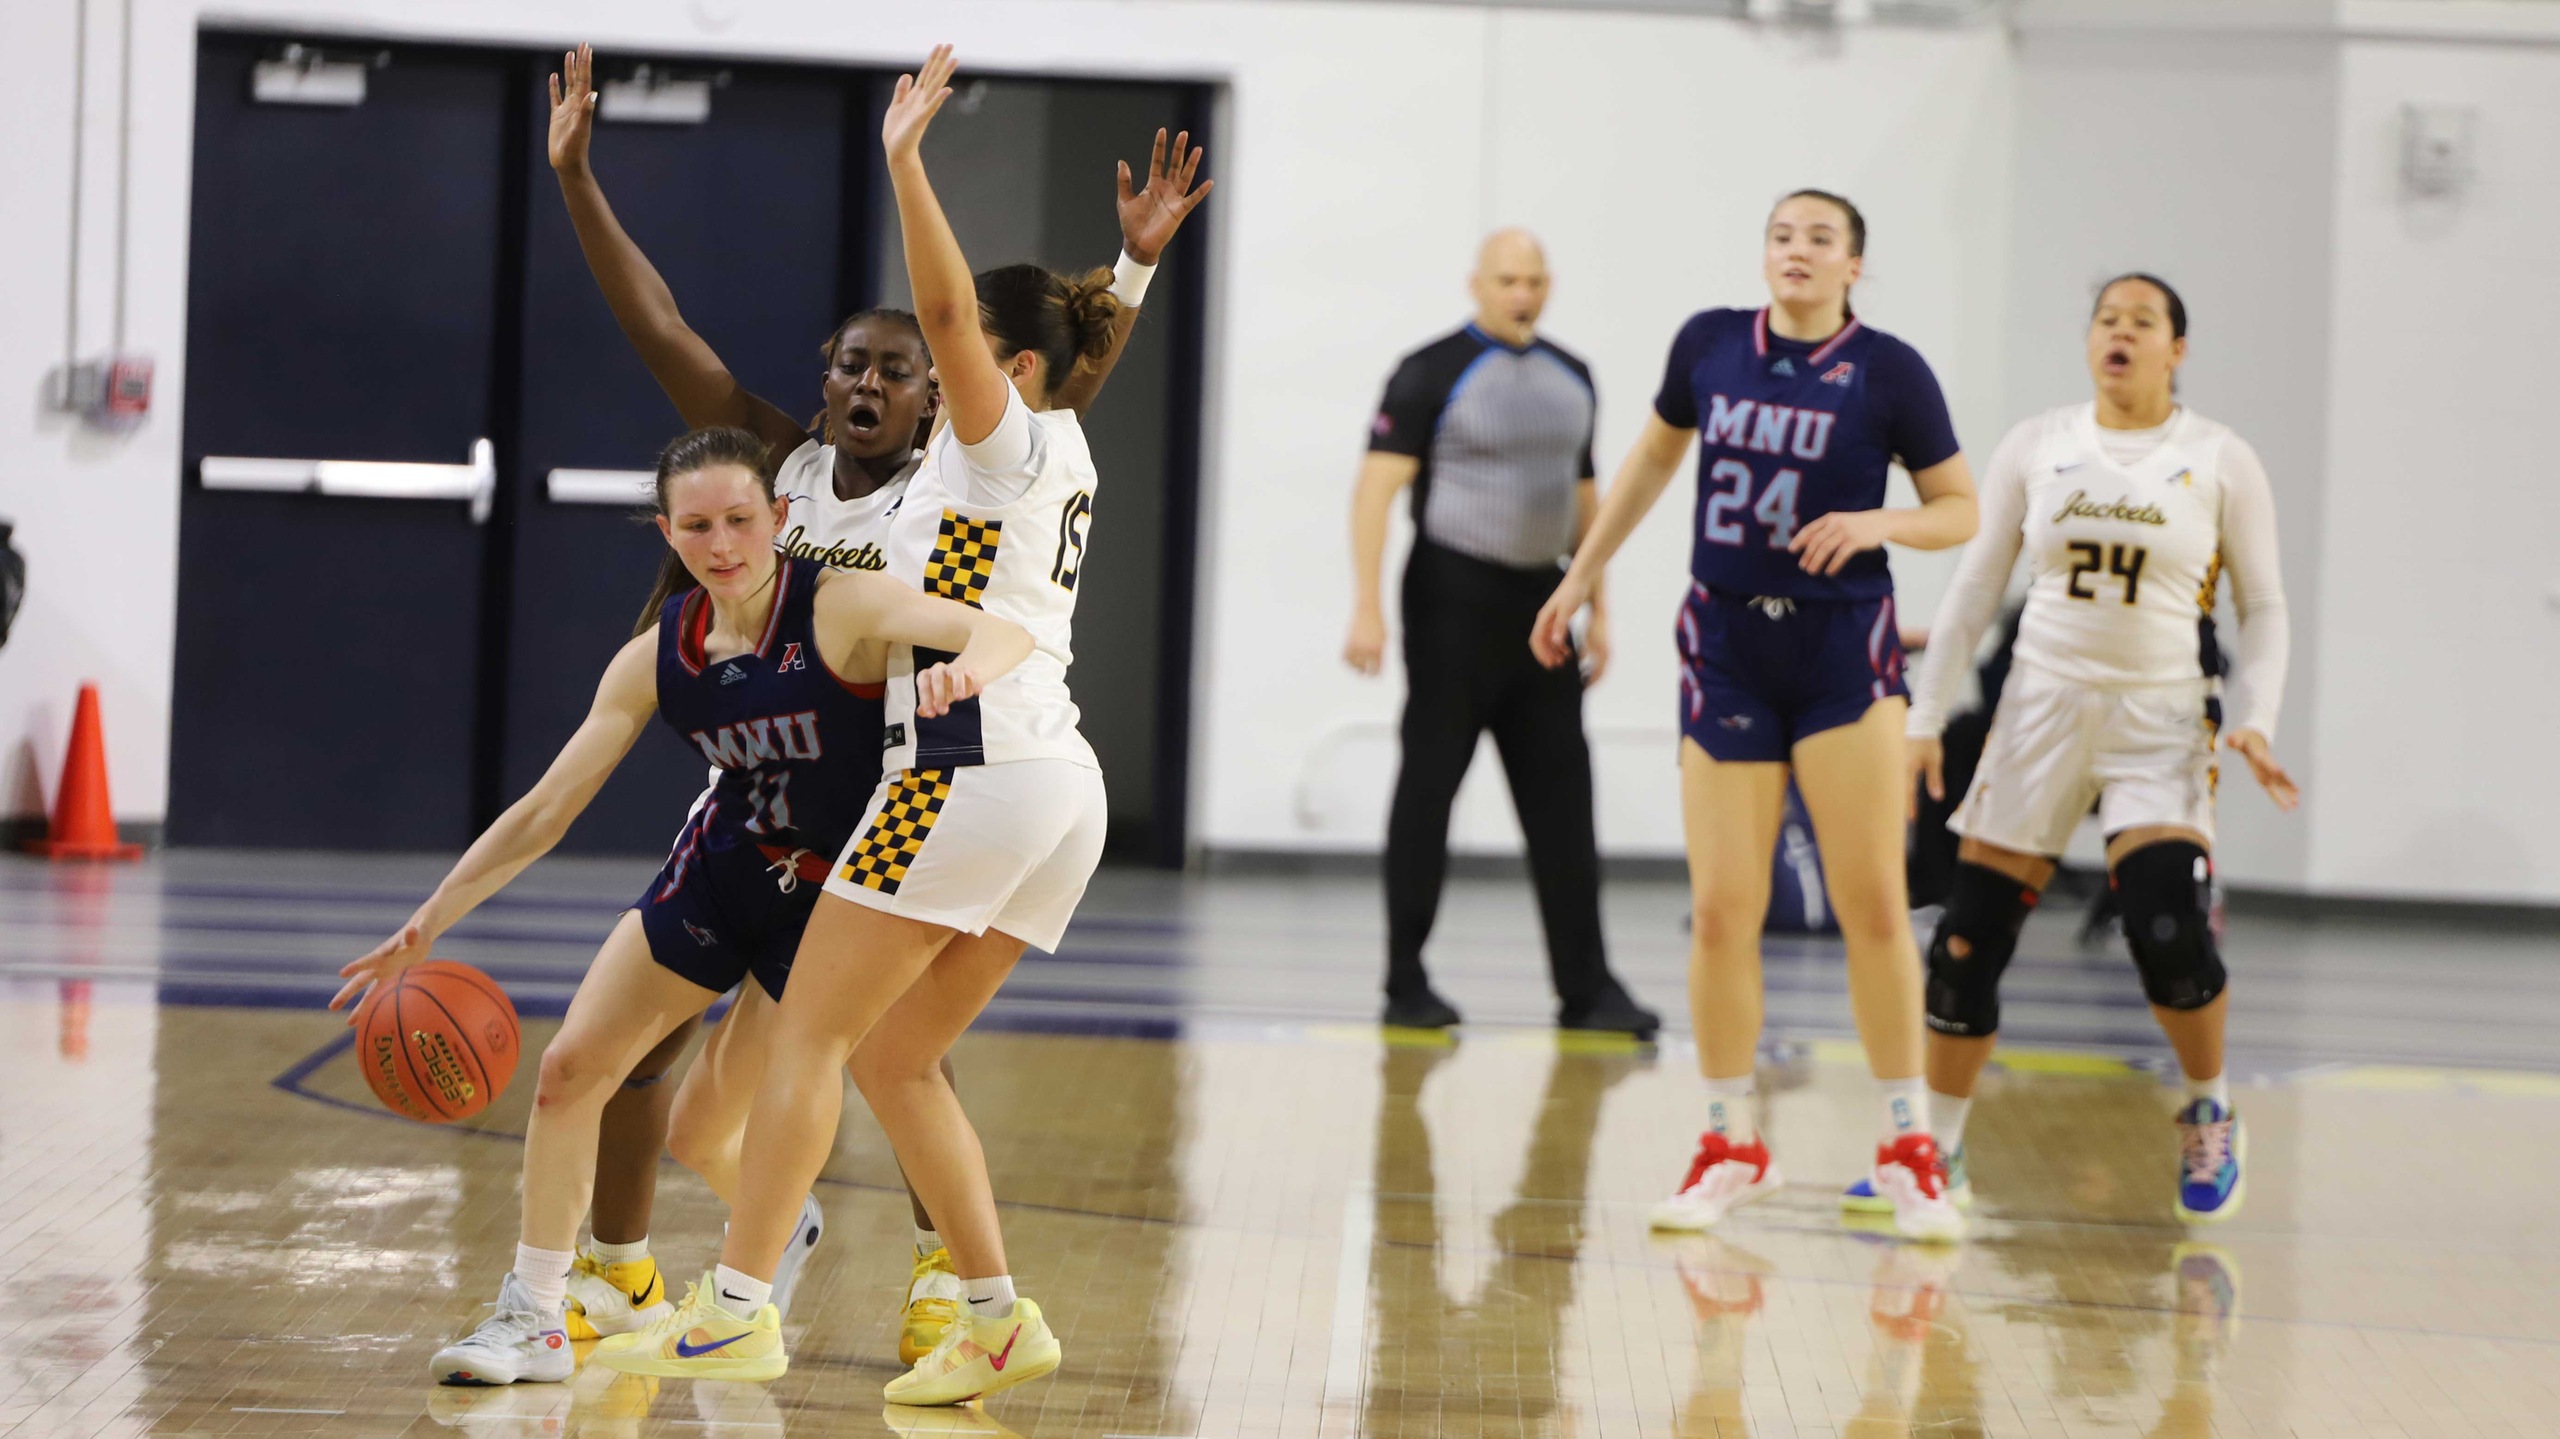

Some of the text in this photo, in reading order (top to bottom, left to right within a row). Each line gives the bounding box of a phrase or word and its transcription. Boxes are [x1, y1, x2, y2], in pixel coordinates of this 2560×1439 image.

[1704, 394, 1836, 463] MNU
[1704, 458, 1804, 549] 24
[2052, 489, 2166, 526] Jackets
[785, 525, 888, 571] Jackets
[2066, 539, 2147, 606] 24
[720, 671, 748, 686] adidas
[689, 709, 823, 770] MNU
[374, 1033, 430, 1121] ALDING
